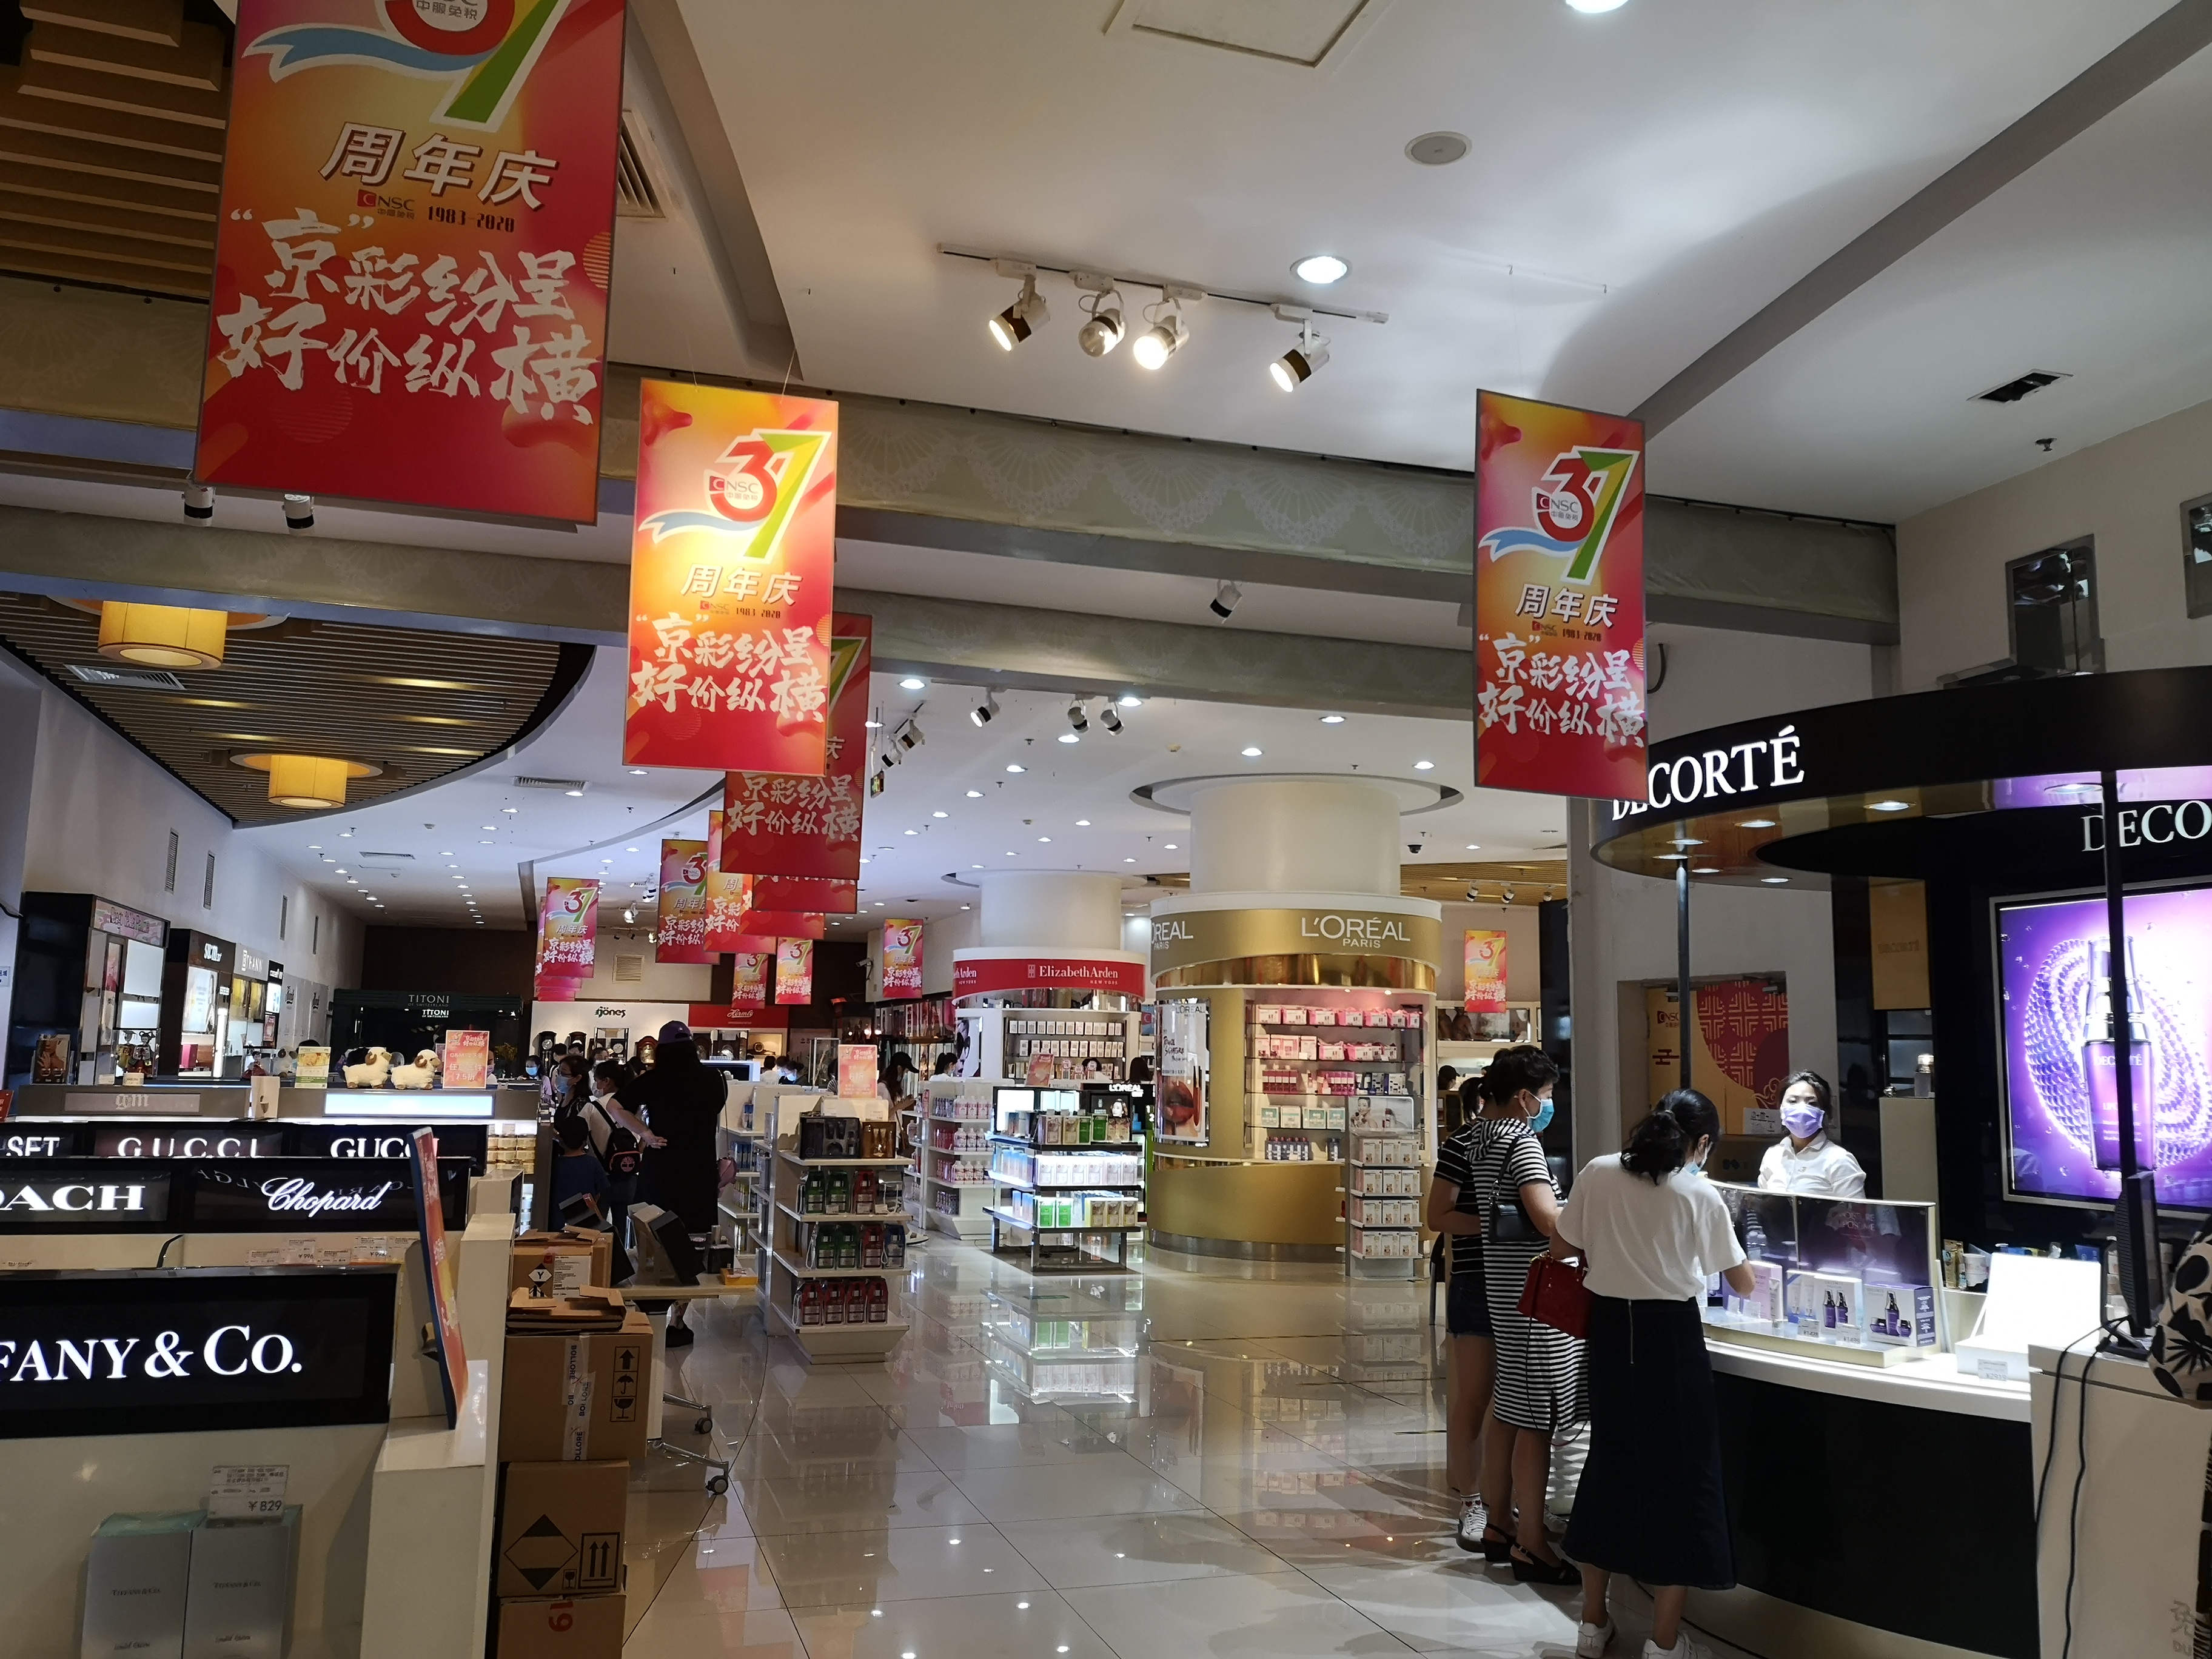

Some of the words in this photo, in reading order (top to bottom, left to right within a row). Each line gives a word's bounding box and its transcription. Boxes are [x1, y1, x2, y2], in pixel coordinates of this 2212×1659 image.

[416, 0, 478, 21] 中服免税
[318, 122, 559, 211] 周年庆
[428, 206, 515, 233] 1983-2020
[216, 293, 600, 427] 好价纵横
[709, 475, 759, 494] CNSC
[1537, 493, 1579, 513] CNSC
[680, 563, 803, 606] 周年庆
[1515, 583, 1618, 628] 周年庆
[631, 660, 828, 723] 好价纵横
[1478, 682, 1644, 749] 好价纵横
[727, 799, 860, 843] 好价纵横
[556, 925, 589, 935] 周年庆
[705, 914, 740, 933] 好价
[1301, 914, 1411, 942] L'ORÉAL
[658, 930, 704, 947] 好价纵
[1154, 940, 1170, 950] PARIS
[1342, 937, 1381, 949] PARIS
[543, 950, 594, 965] 好价纵横
[1039, 965, 1089, 977] Elizabeth
[1091, 967, 1118, 979] Arden
[408, 994, 449, 1004] TITONI
[118, 1136, 262, 1157] GUCCI
[0, 1185, 146, 1212] ACH
[261, 1177, 392, 1217] Chopard
[144, 1331, 194, 1378] &
[248, 1500, 282, 1512] ¥829
